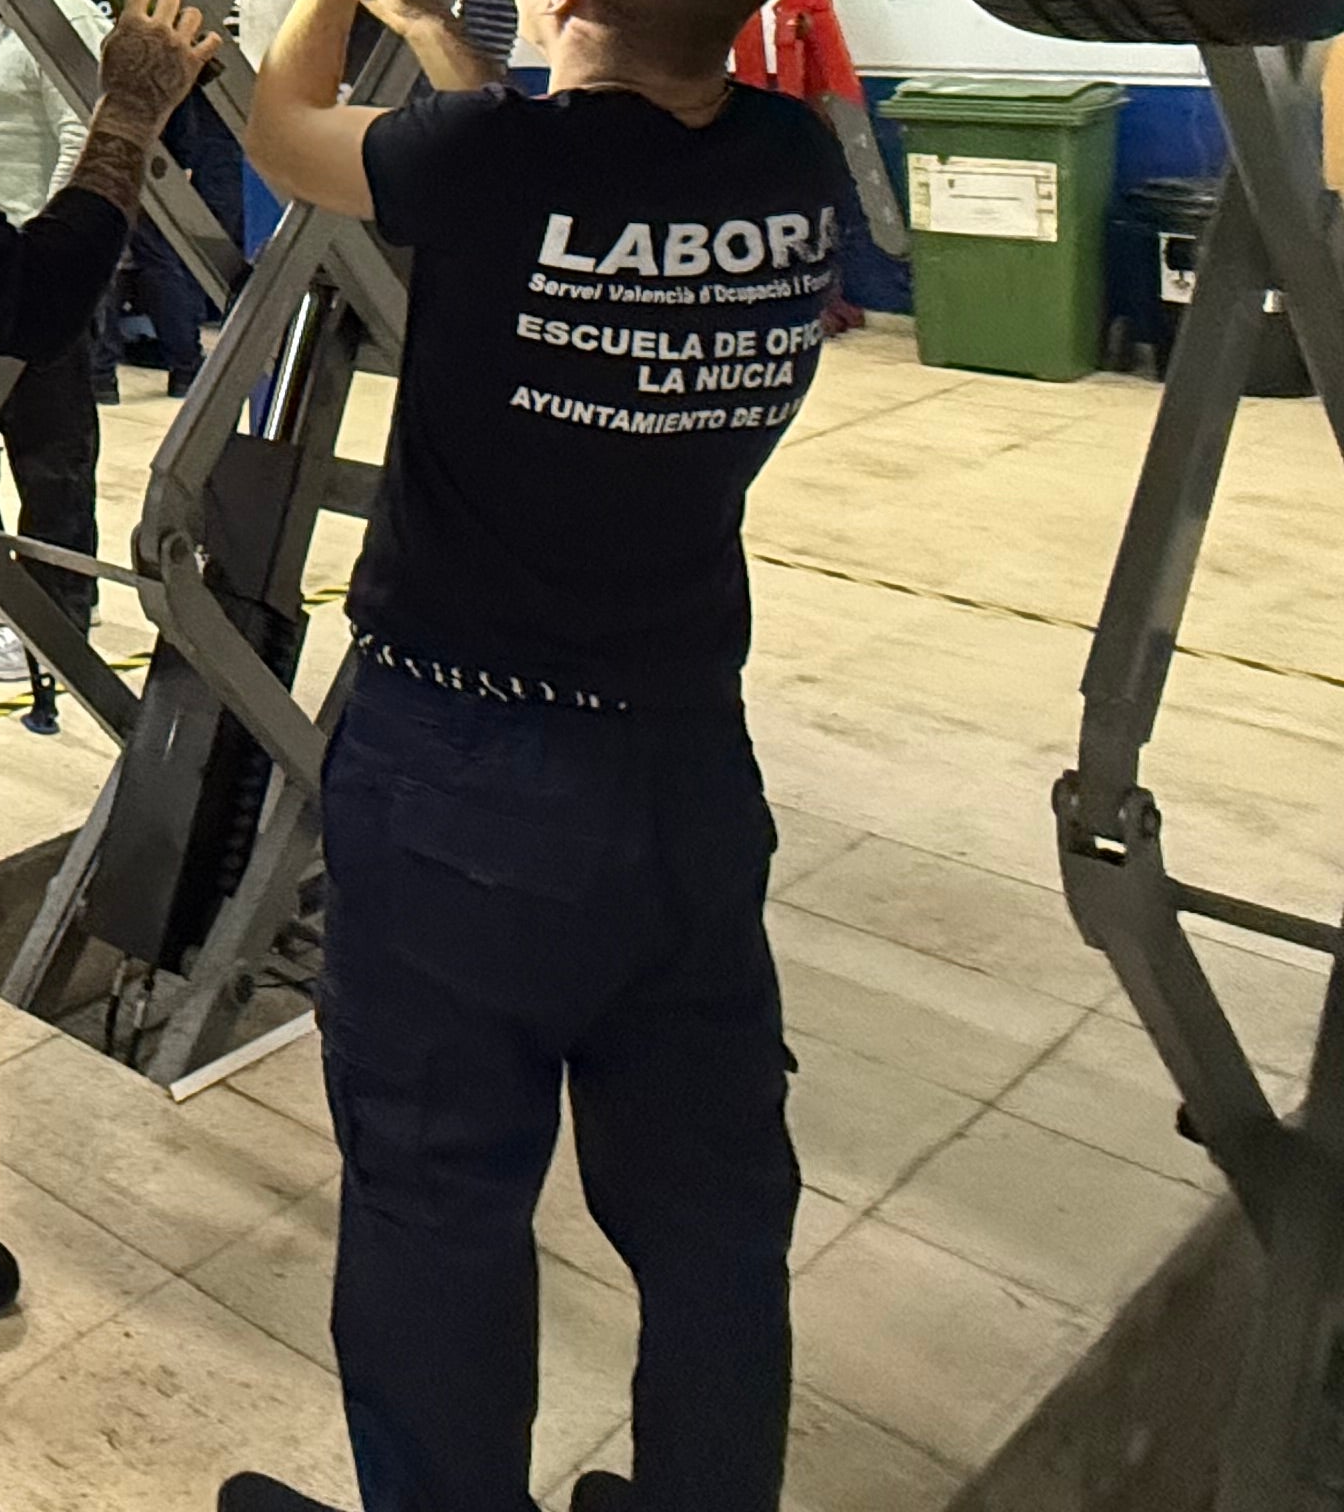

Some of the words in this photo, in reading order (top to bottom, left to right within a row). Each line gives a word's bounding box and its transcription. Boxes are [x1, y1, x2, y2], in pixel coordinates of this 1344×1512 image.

[516, 311, 705, 361] ESCUELA
[714, 329, 758, 358] DE
[638, 365, 686, 395] LA
[695, 361, 794, 392] NUCIA
[509, 385, 728, 435] AYUNTAMIENTO
[729, 405, 764, 429] DE
